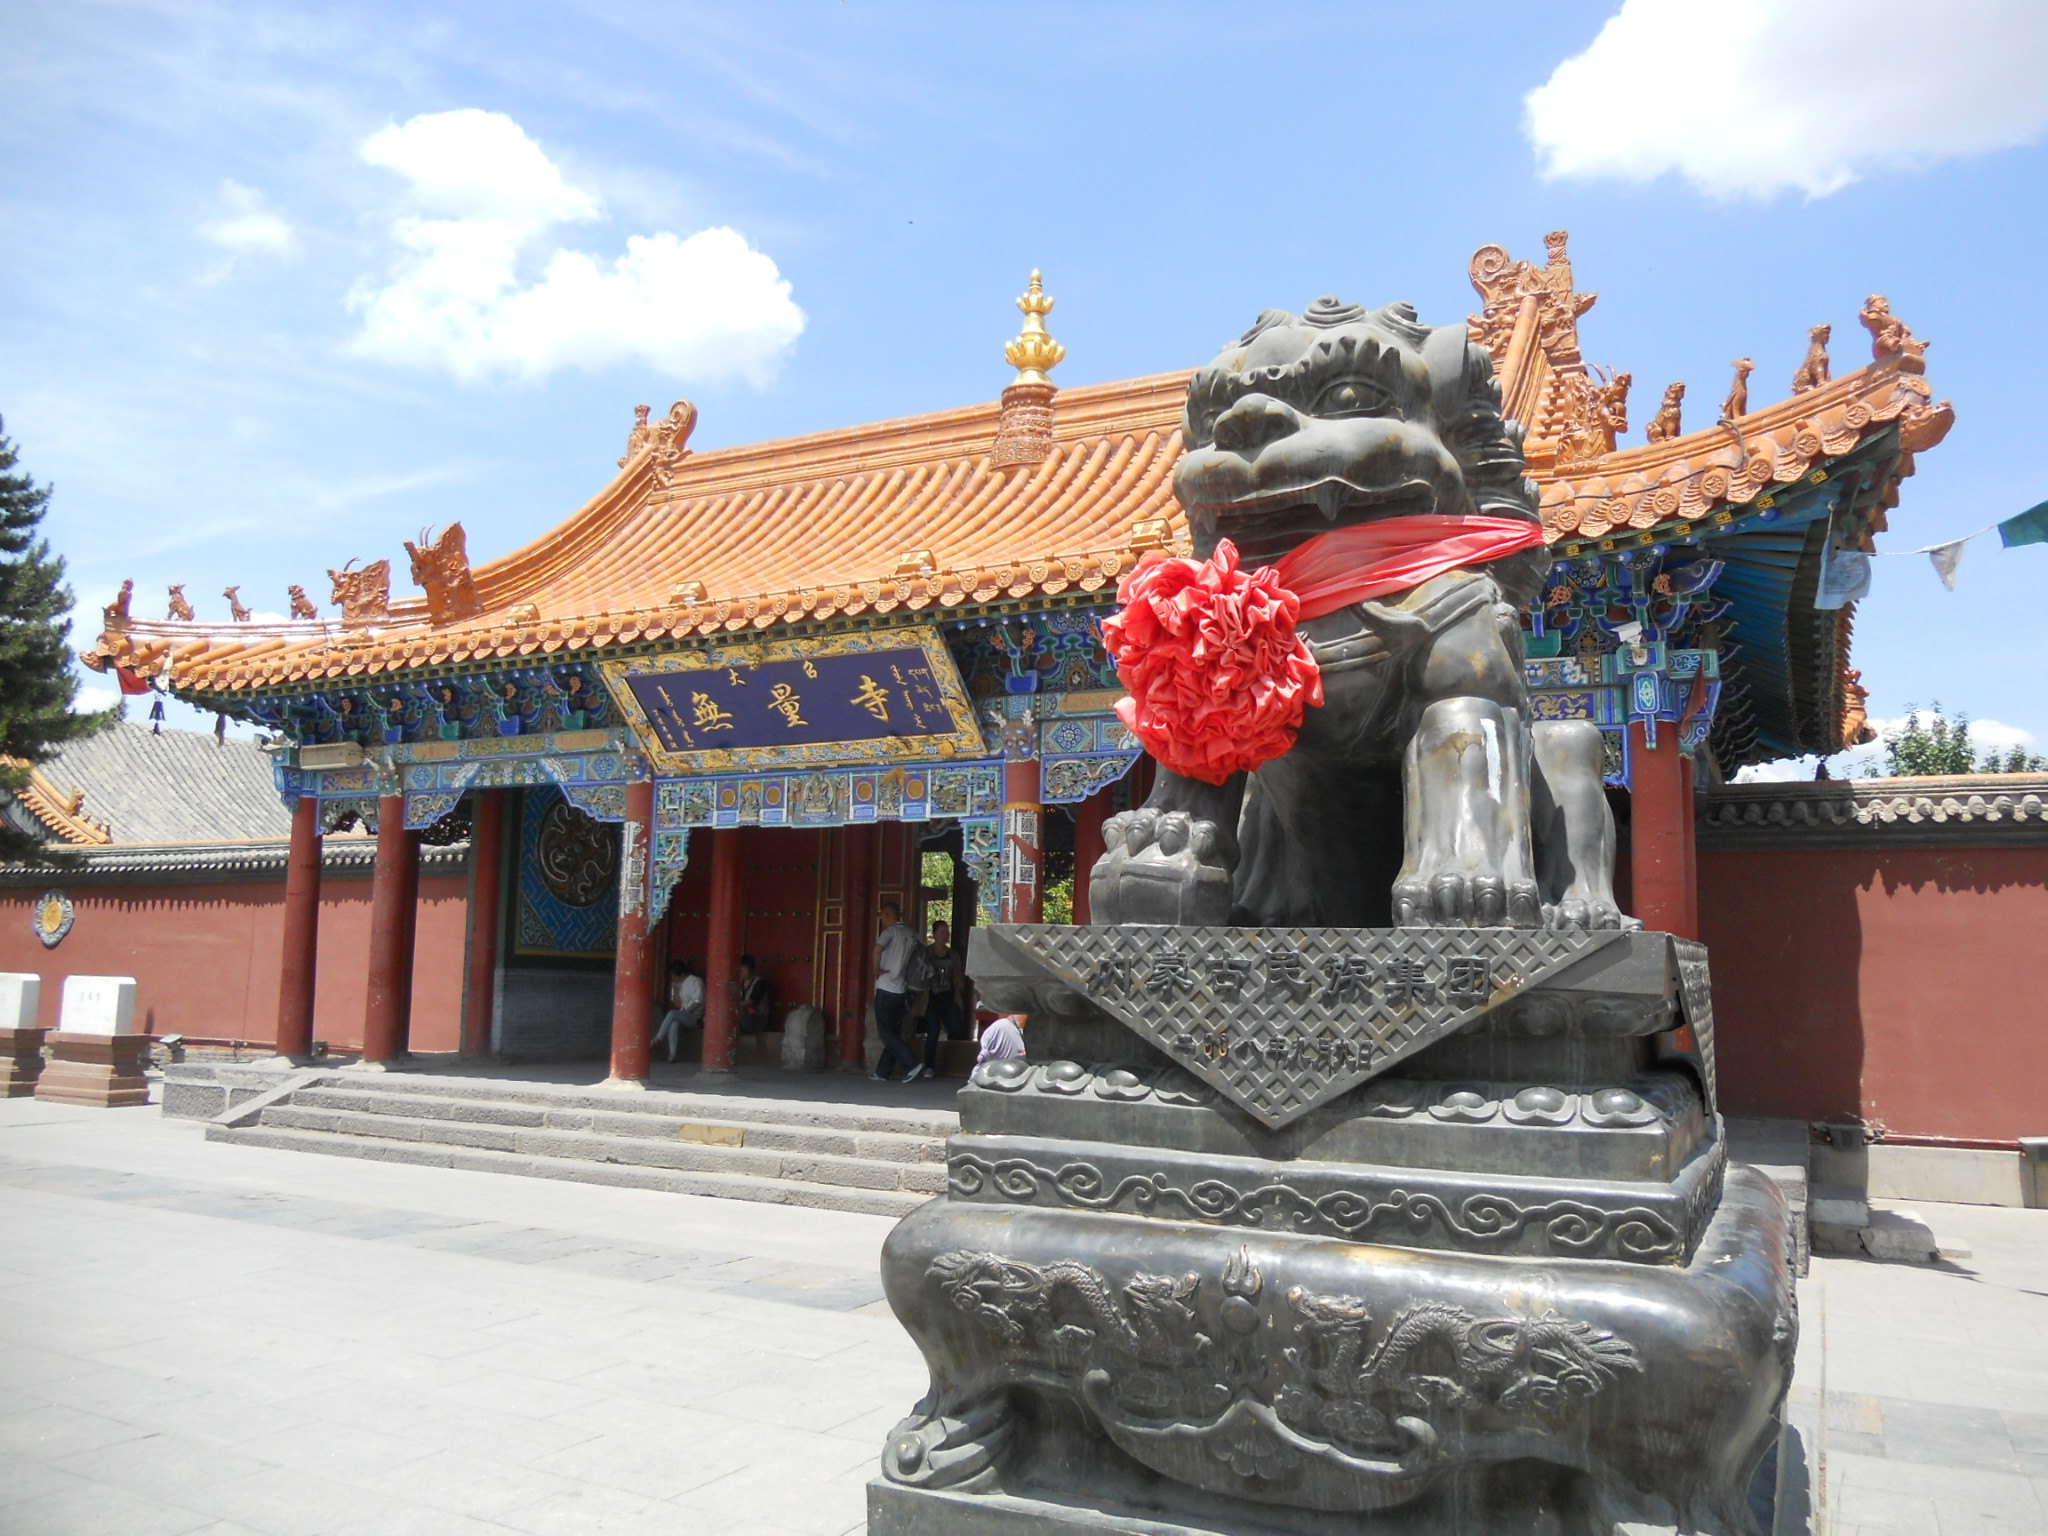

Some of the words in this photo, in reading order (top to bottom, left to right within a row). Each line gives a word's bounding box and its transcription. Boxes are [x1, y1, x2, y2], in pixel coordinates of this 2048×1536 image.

[692, 674, 890, 733] 無量寺
[1091, 948, 1491, 1001] 内蒙古民族集团
